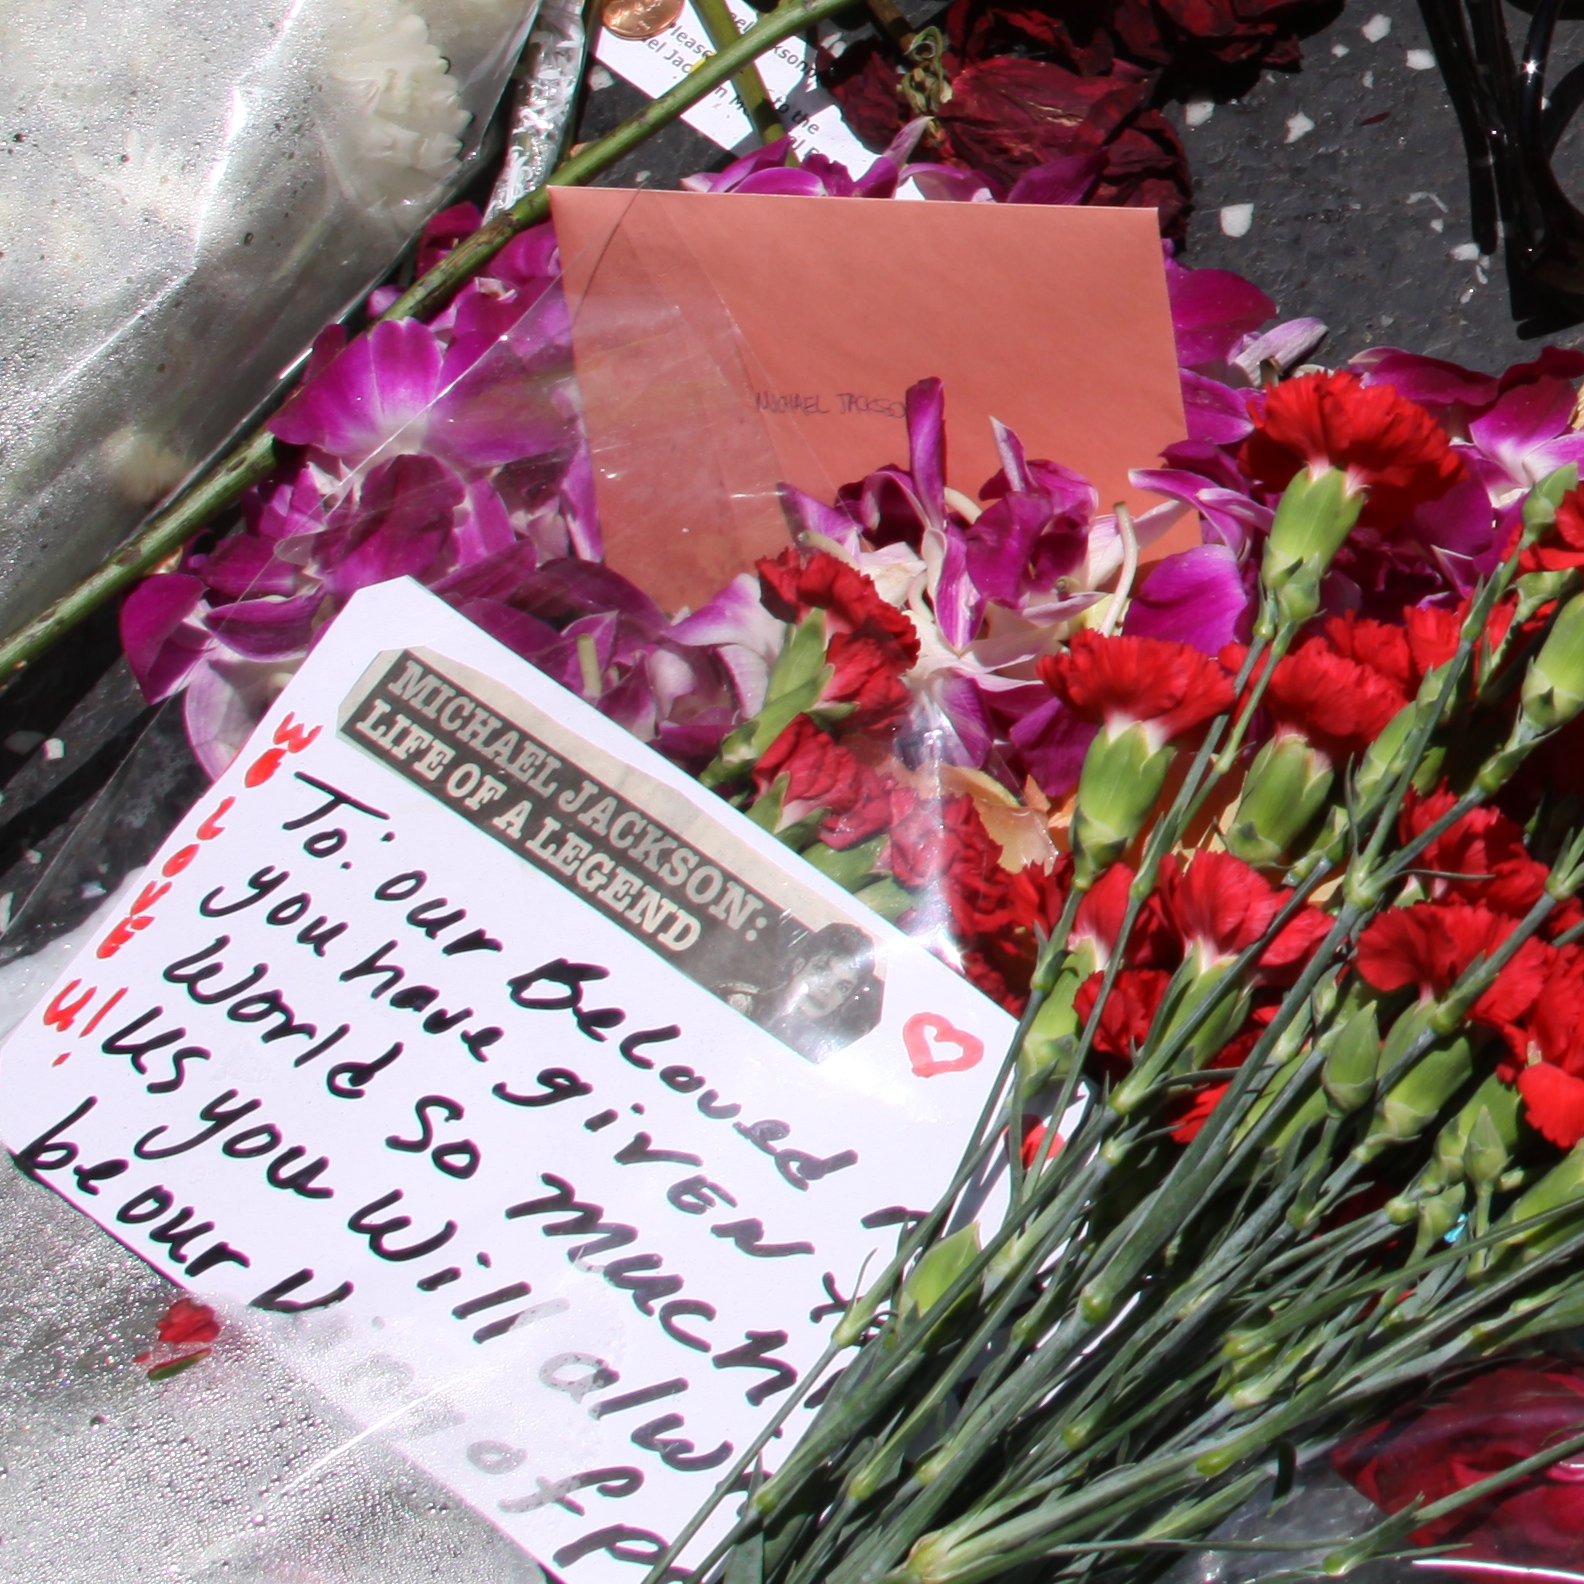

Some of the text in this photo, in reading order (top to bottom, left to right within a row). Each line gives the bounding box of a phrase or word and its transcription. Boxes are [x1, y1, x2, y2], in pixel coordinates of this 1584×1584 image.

[790, 108, 822, 136] the
[355, 699, 702, 954] LIFE OF A LEGEND
[387, 659, 767, 944] MICHAEL JACKSON:
[199, 864, 351, 959] you
[338, 939, 506, 1064] have
[373, 869, 504, 957] our
[8, 1095, 130, 1197] be
[115, 1183, 253, 1280] our
[133, 1088, 336, 1199] you
